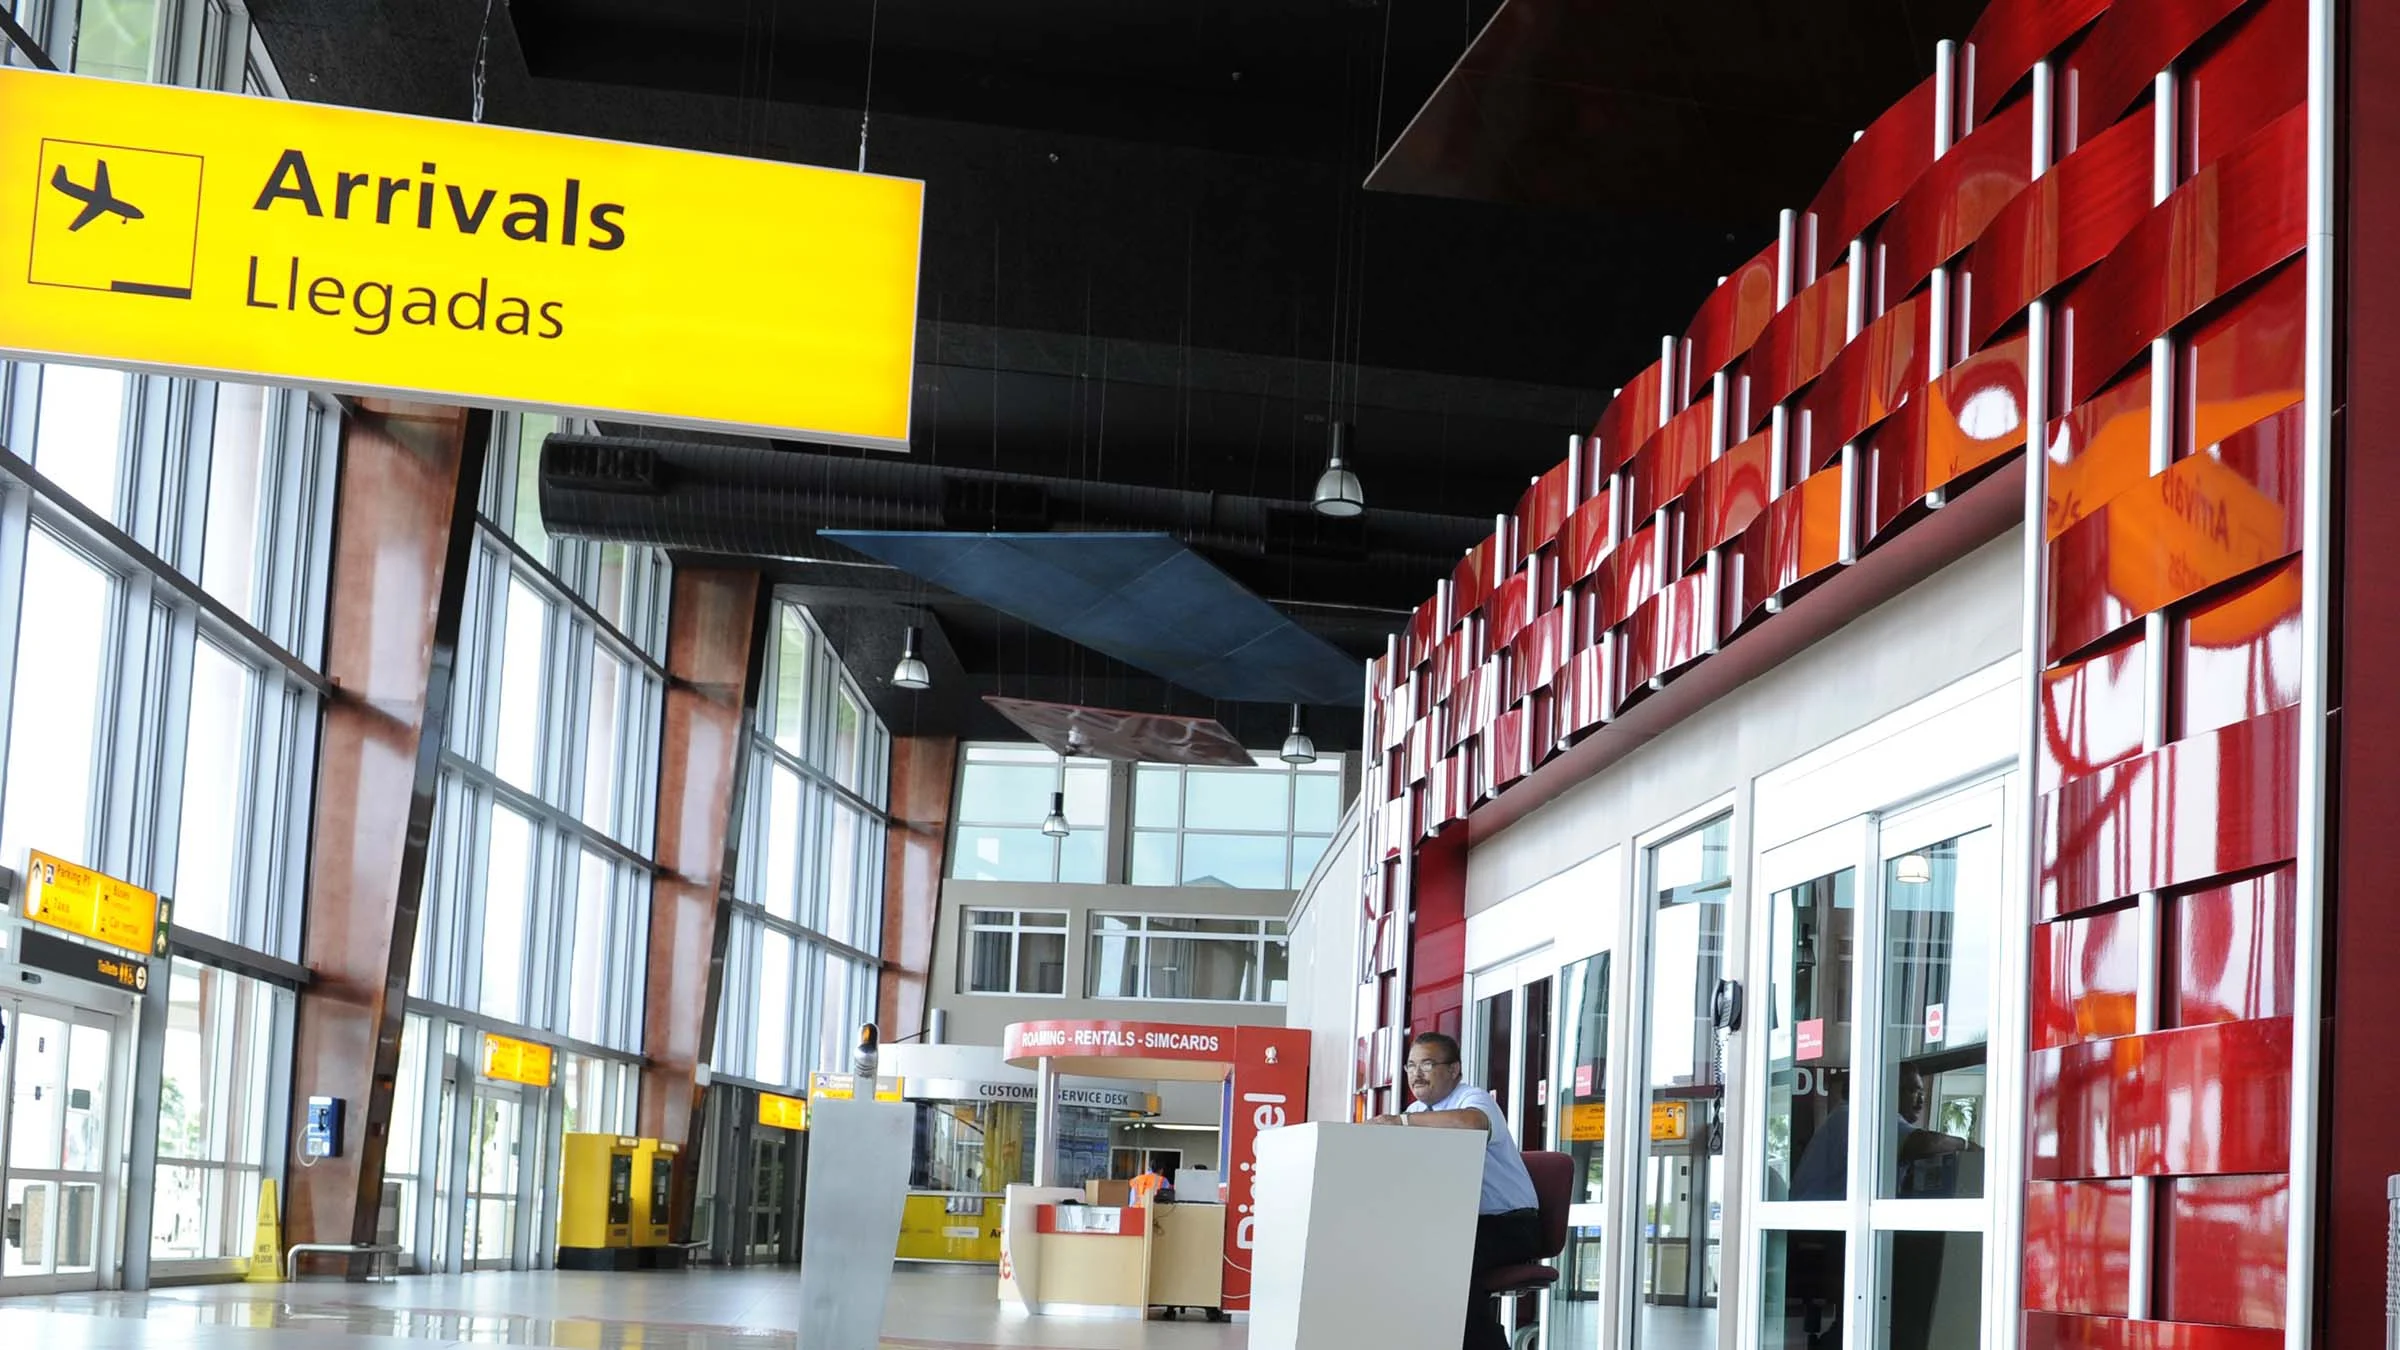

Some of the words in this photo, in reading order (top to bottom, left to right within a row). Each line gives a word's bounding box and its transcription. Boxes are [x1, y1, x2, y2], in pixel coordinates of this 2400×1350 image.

[253, 149, 626, 251] Arrivals
[245, 255, 564, 339] Llegadas
[1022, 1030, 1065, 1048] ROAMING
[1074, 1030, 1135, 1047] RENTALS
[1145, 1032, 1219, 1051] SIMCARDS
[979, 1083, 1038, 1098] CUSTOM
[1104, 1093, 1129, 1106] DESK
[255, 1253, 273, 1264] FLOOR
[259, 1243, 271, 1253] WET
